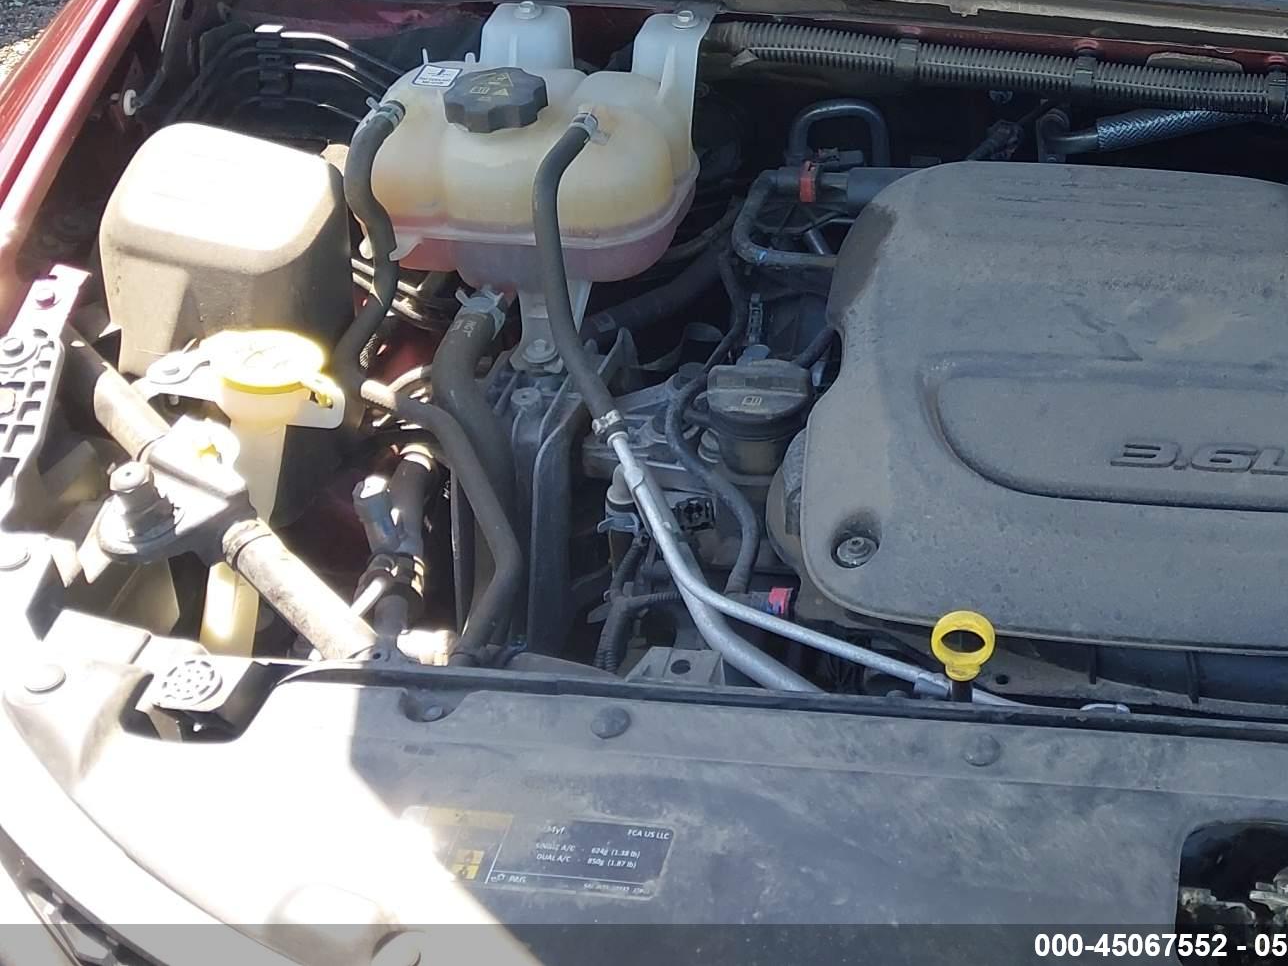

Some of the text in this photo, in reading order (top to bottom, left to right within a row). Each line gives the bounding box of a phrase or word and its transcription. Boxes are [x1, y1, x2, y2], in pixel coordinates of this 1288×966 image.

[627, 828, 670, 840] FCA US LLC
[560, 844, 576, 852] A/C
[536, 853, 572, 863] DUAL A/C
